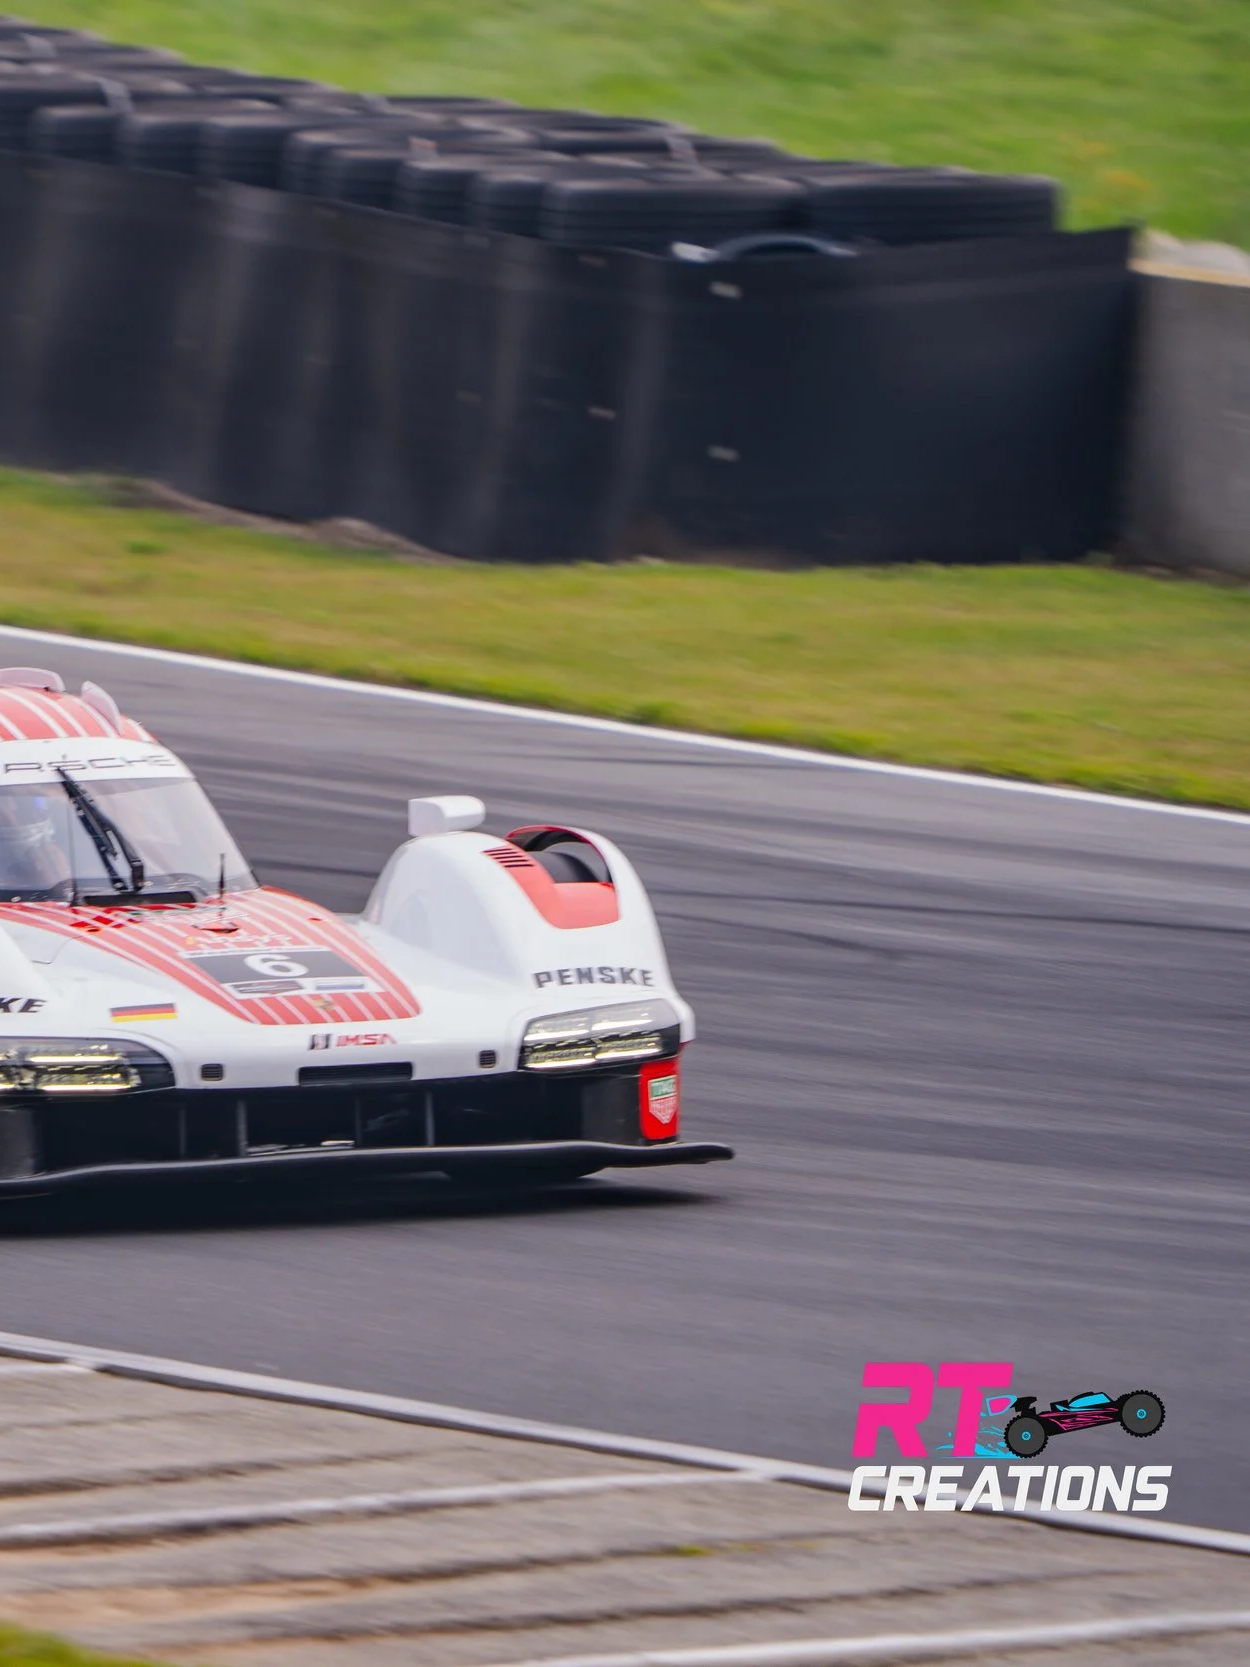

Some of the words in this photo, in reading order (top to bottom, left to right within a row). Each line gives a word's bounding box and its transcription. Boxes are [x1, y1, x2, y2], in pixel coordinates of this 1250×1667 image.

[244, 953, 309, 977] 6
[531, 966, 656, 988] PENSKE
[335, 1033, 398, 1047] IMSA
